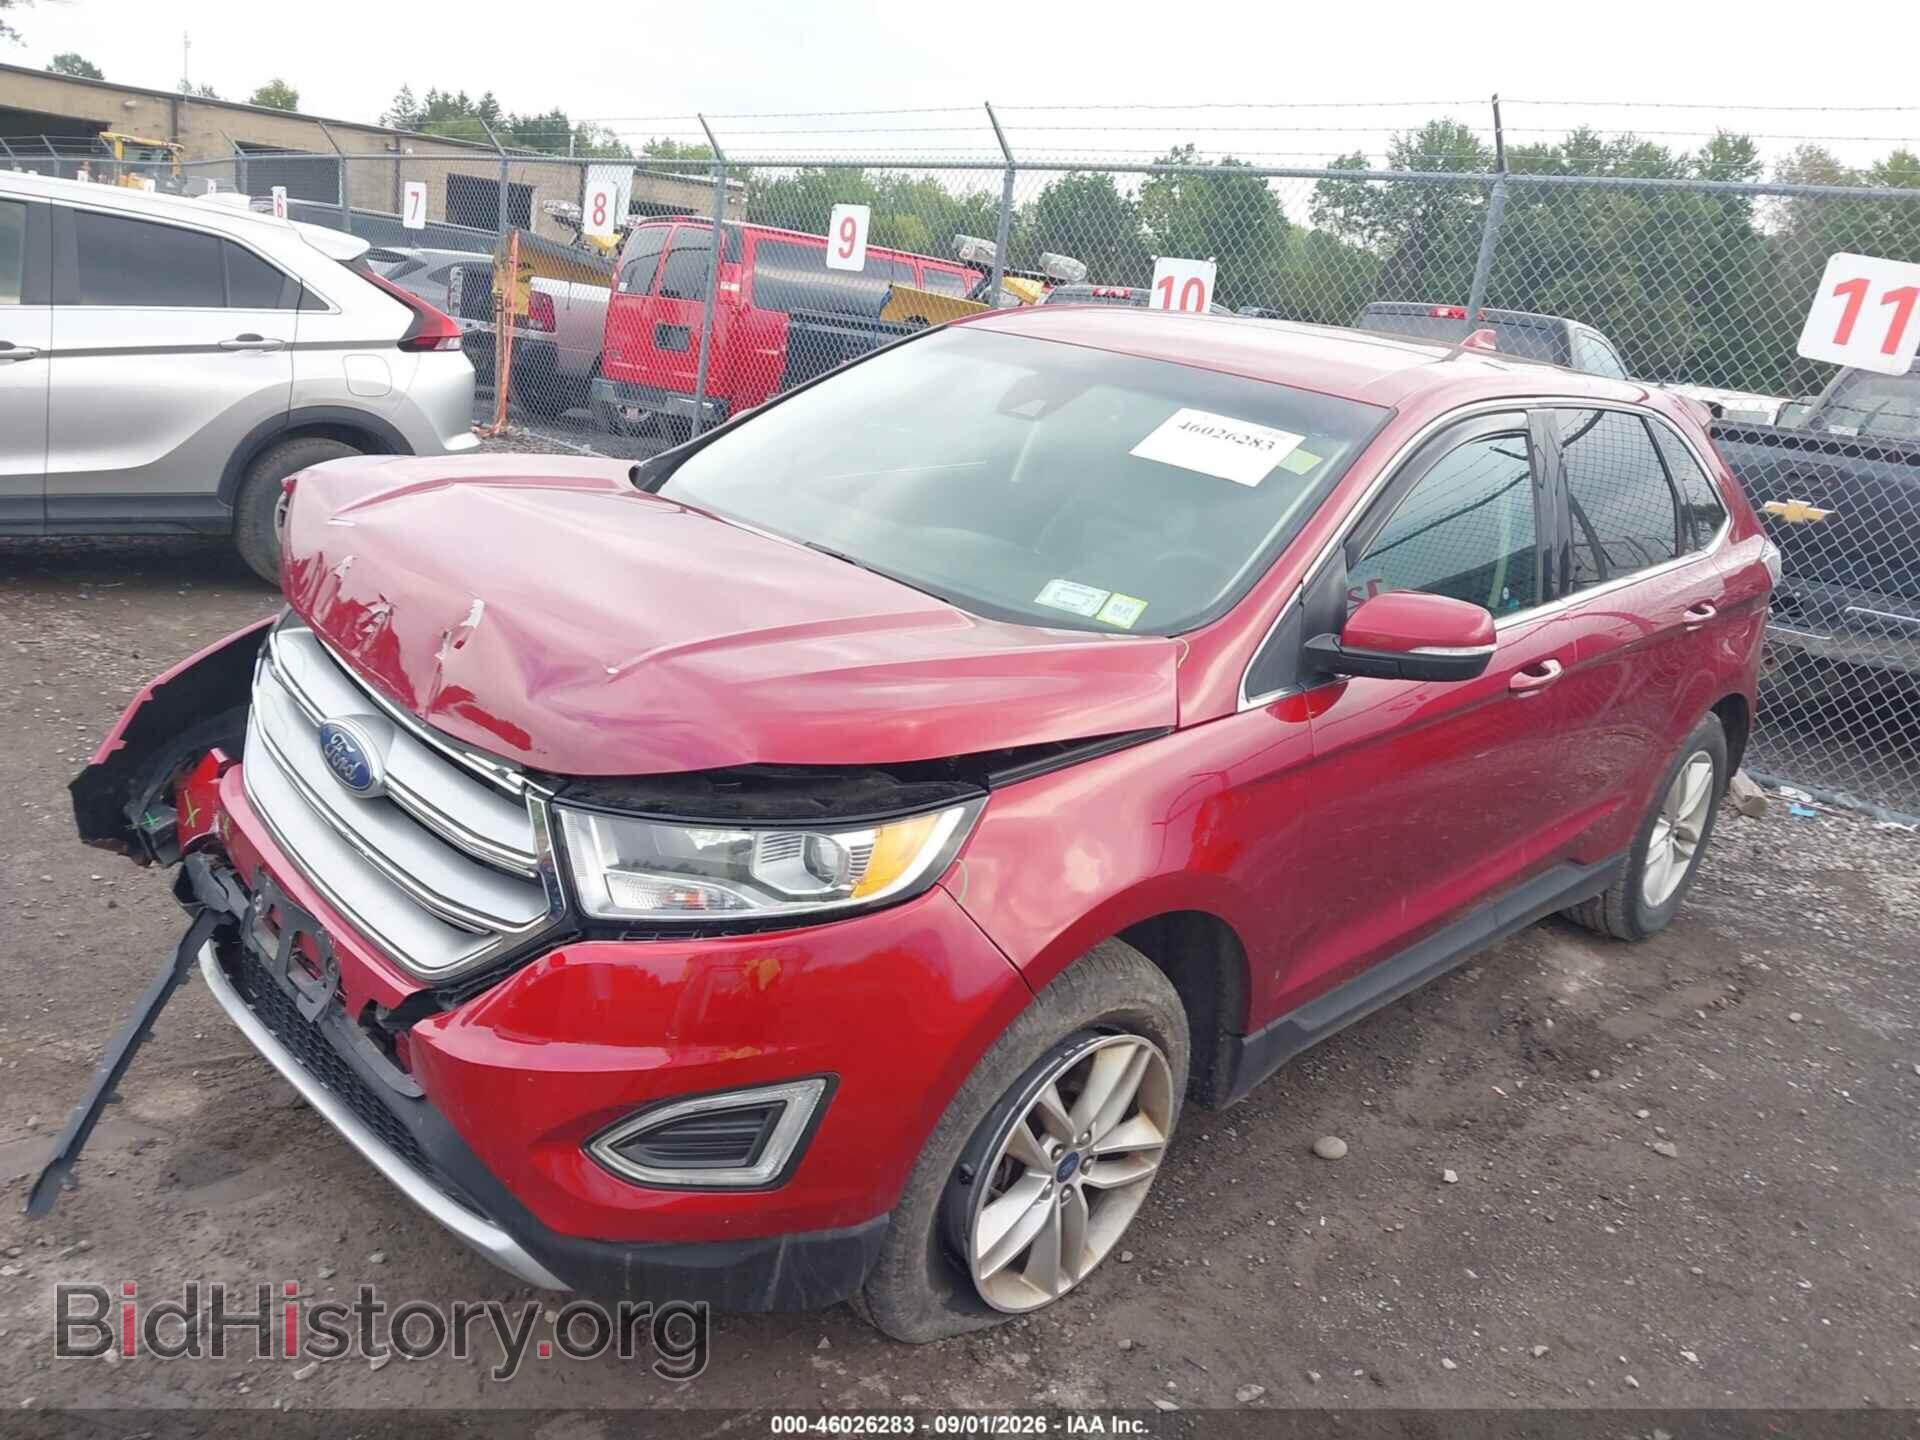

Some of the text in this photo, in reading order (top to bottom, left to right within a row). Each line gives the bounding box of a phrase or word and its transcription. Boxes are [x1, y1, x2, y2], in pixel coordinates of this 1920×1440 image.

[410, 191, 420, 221] 7
[592, 192, 607, 226] 8
[838, 216, 856, 259] 9
[1157, 275, 1205, 312] 10
[1832, 278, 1920, 355] 11
[1178, 421, 1275, 450] 46026283
[325, 732, 362, 781] Ford
